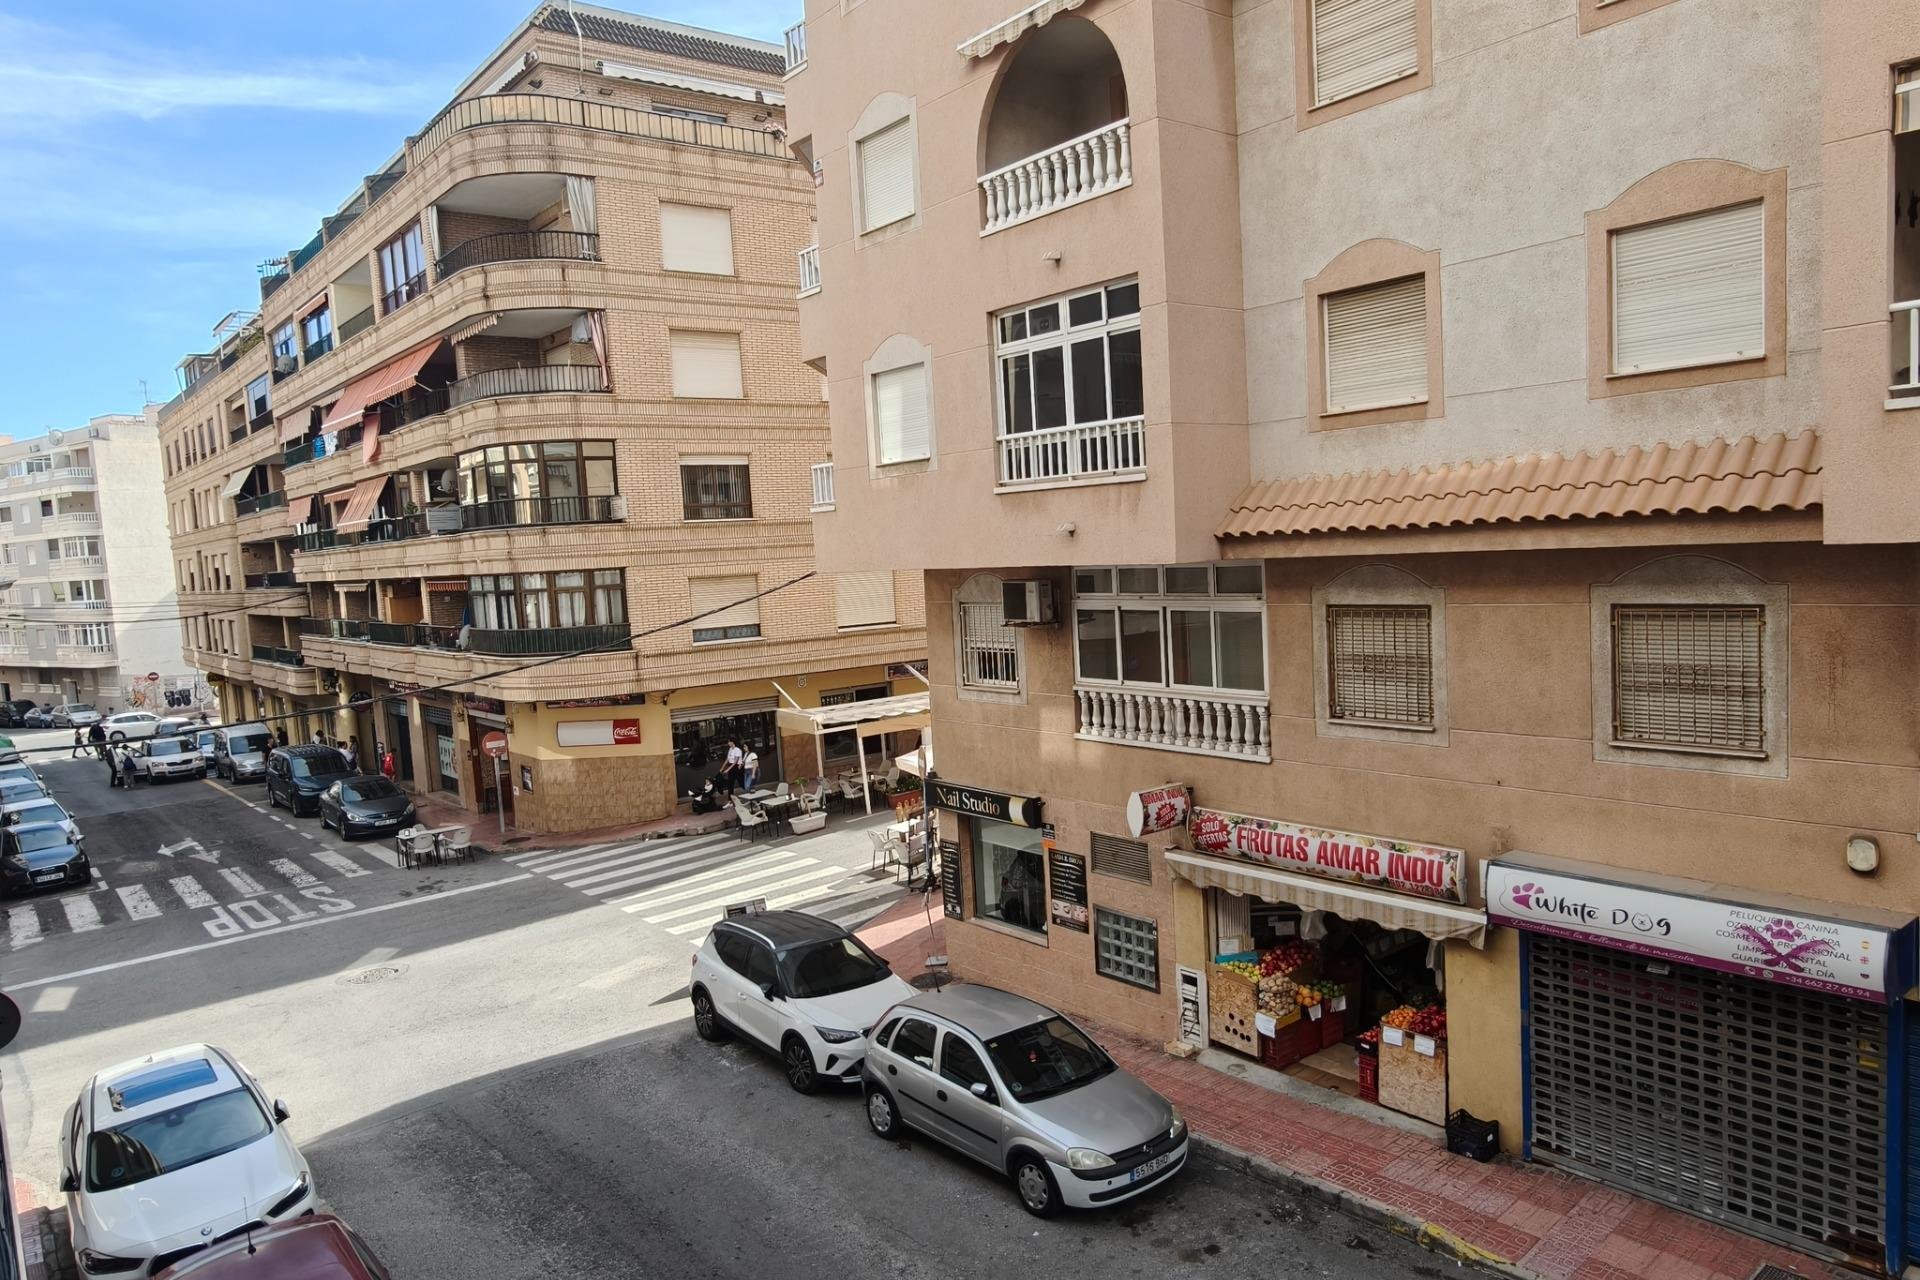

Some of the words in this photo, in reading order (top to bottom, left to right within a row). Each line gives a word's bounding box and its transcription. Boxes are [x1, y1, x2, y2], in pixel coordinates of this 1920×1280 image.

[936, 786, 960, 808] Nail
[962, 791, 1000, 816] Studio
[1201, 820, 1220, 833] SOLO
[1197, 831, 1229, 845] OFERTAS
[1236, 825, 1310, 862] FRUTAS
[1316, 840, 1380, 876] AMAR
[1387, 852, 1444, 888] INDU
[201, 885, 357, 938] STOP
[1535, 895, 1600, 924] White
[1796, 921, 1840, 936] CANINA
[1653, 949, 1695, 962] mascota
[1816, 967, 1836, 980] DÍA
[1785, 975, 1802, 984] +34
[1804, 979, 1824, 988] 662
[1825, 982, 1839, 990] 27
[1841, 986, 1854, 995] 65
[1856, 989, 1870, 997] 94
